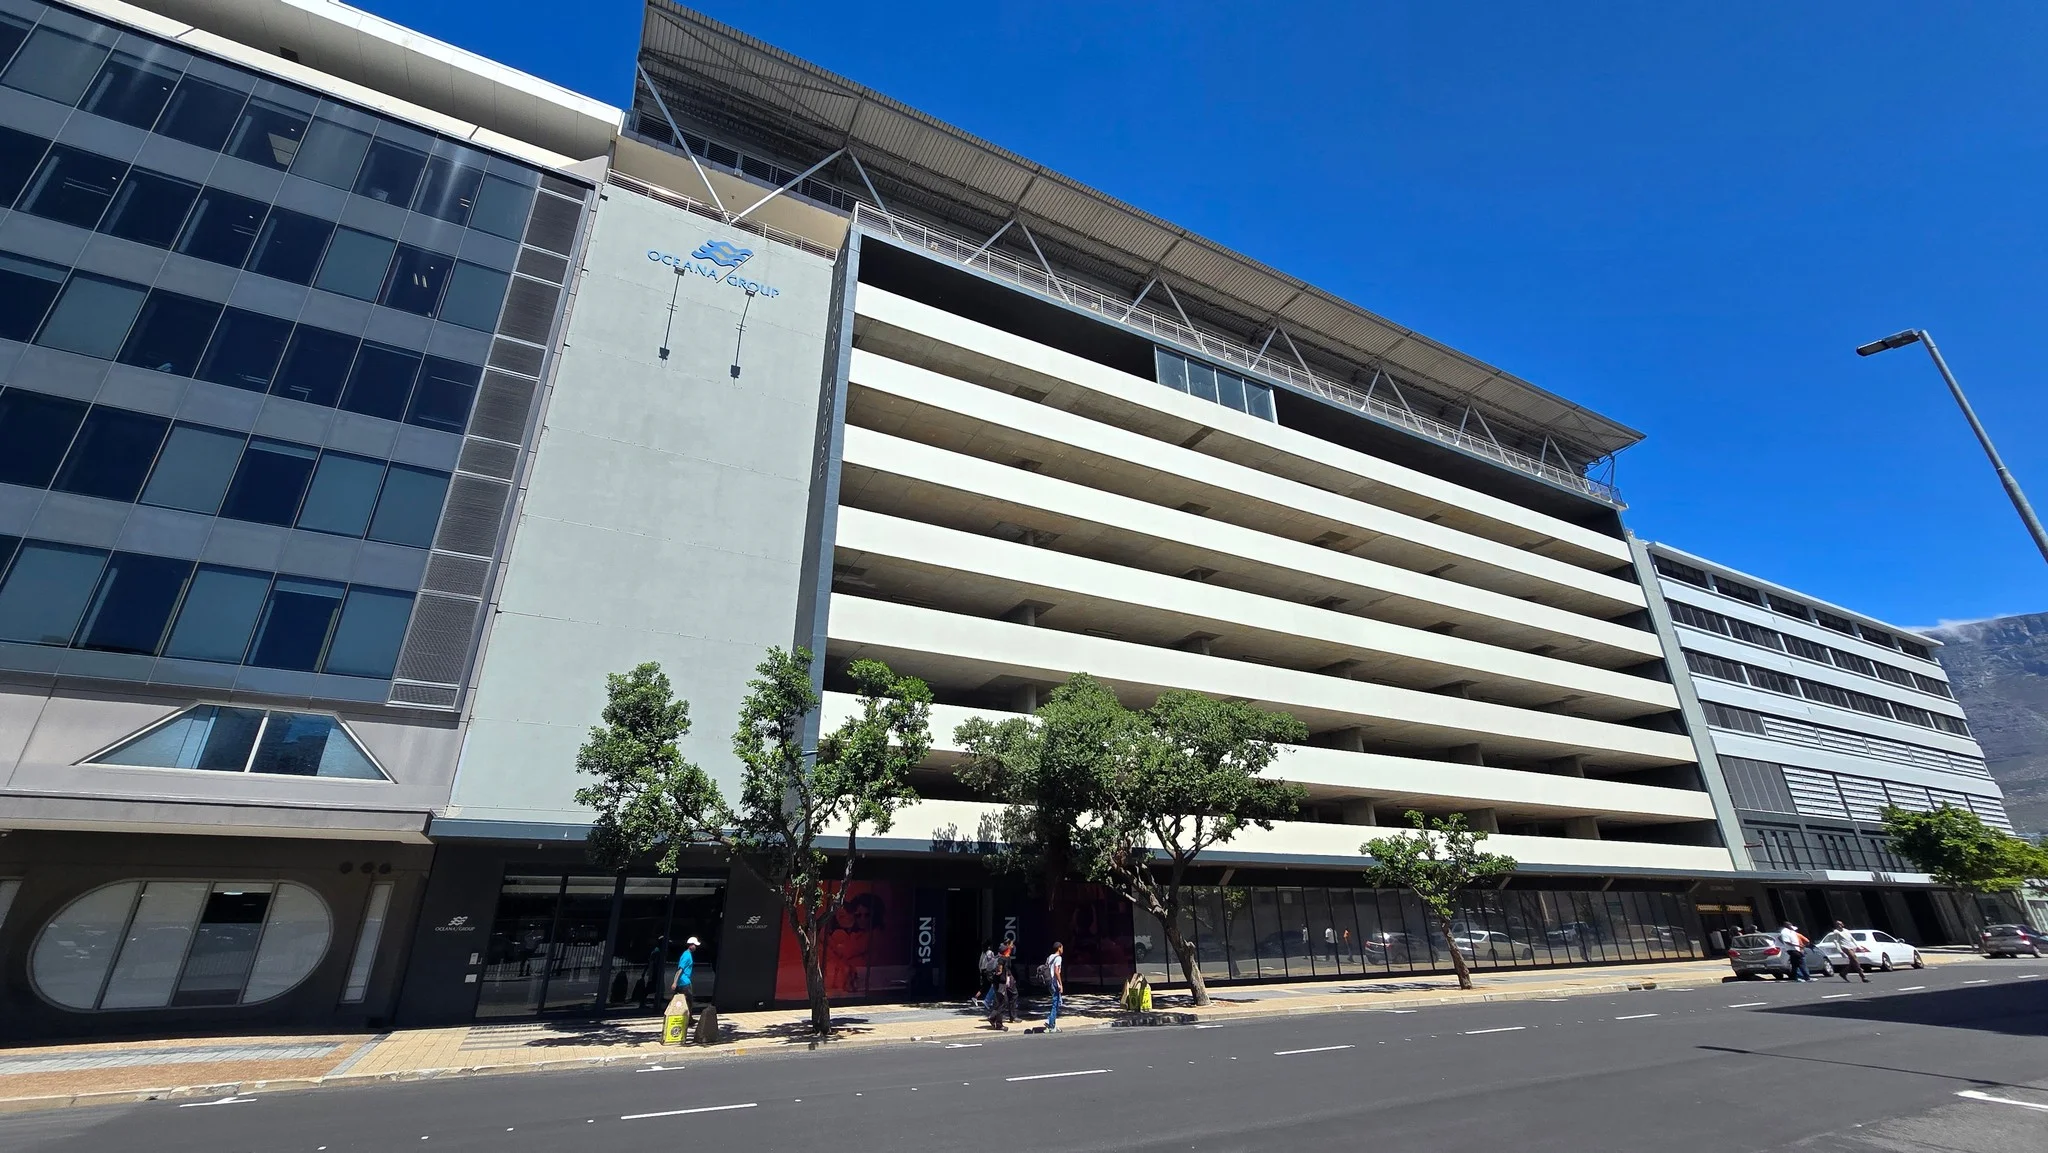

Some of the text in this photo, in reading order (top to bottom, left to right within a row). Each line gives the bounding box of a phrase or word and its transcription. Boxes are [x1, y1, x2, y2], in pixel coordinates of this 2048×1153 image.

[647, 249, 780, 299] OCEANA GROUP
[818, 376, 834, 480] HOUSE
